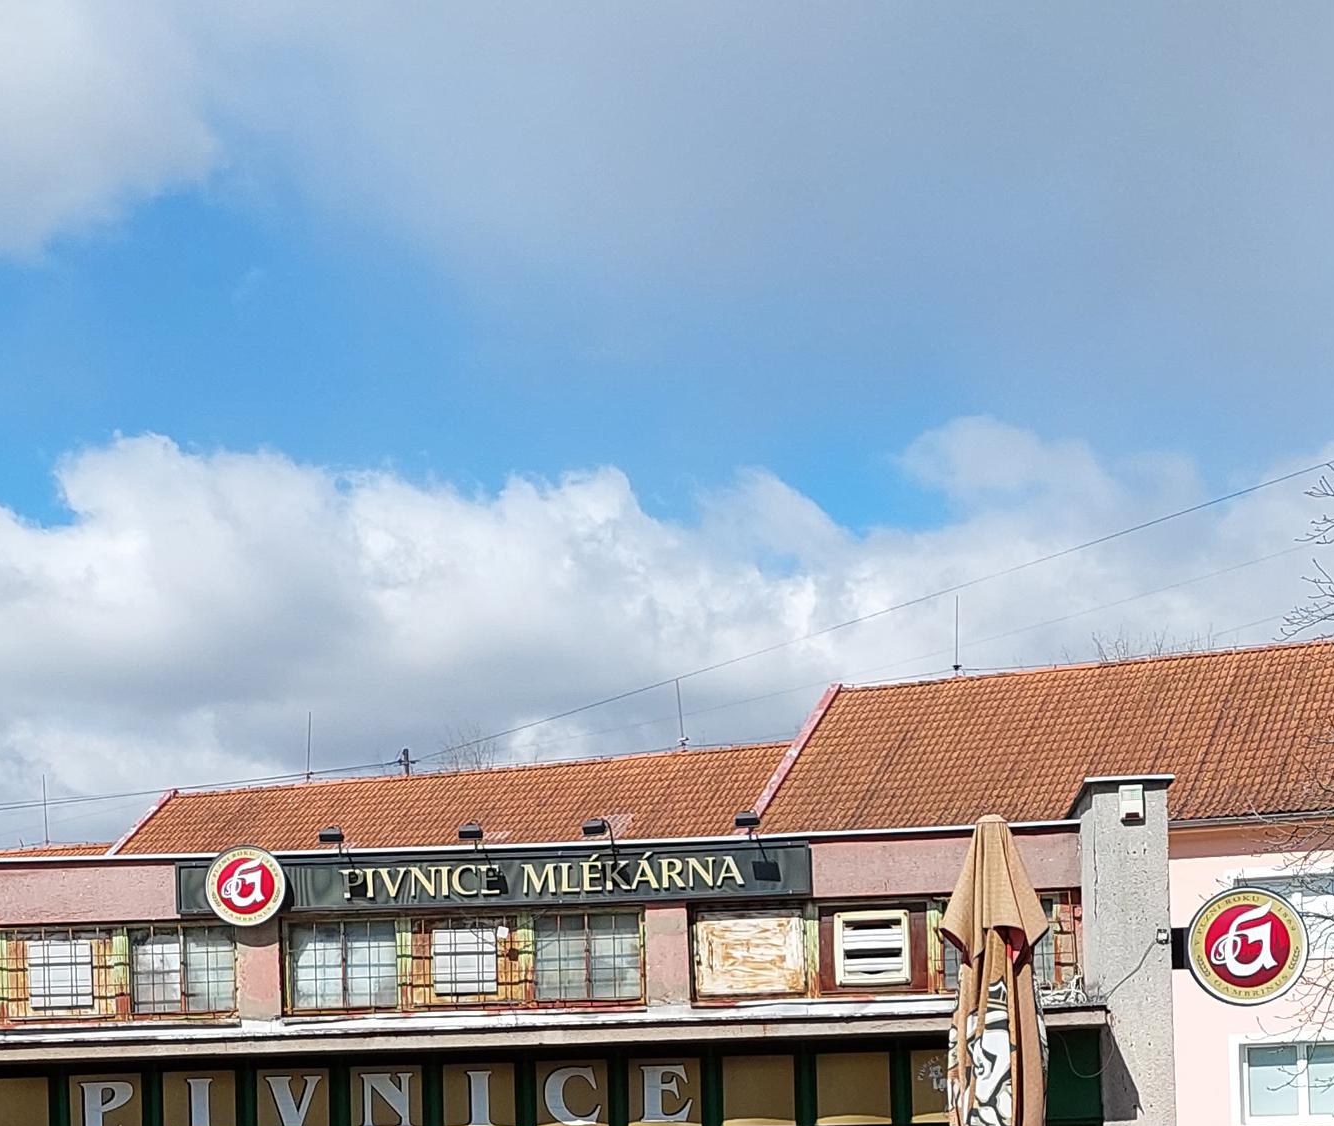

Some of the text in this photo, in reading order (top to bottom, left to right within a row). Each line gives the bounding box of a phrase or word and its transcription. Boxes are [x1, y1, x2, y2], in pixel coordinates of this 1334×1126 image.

[338, 852, 746, 899] PIVNICE MLÉKÁRNA
[1224, 895, 1261, 906] ROKU
[1213, 974, 1288, 998] GAMBRINUS
